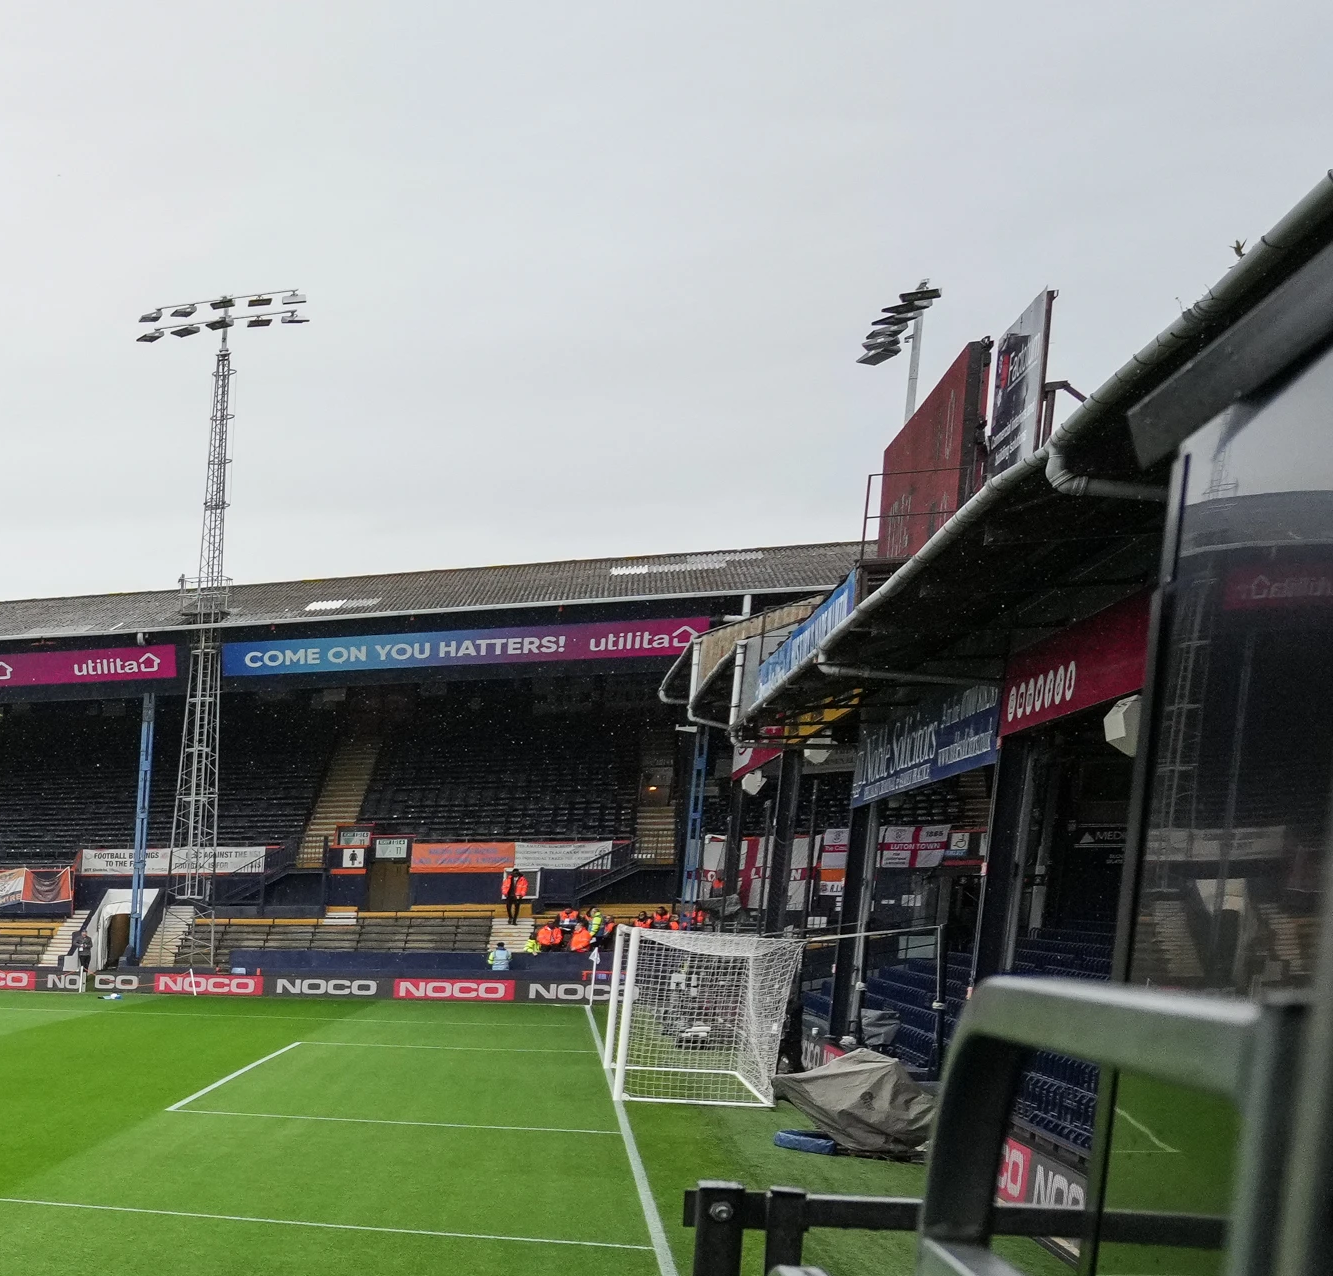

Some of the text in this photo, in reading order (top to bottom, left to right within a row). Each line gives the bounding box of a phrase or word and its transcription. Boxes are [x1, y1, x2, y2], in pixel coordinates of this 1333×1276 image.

[245, 630, 670, 668] COME ON YOU HATTERS! utilita
[73, 658, 138, 676] utilita
[893, 712, 938, 771] Solicitors
[93, 852, 127, 860] FOOTBALL
[105, 860, 128, 868] TO THE
[159, 975, 256, 993] NOCO
[277, 978, 377, 995] NOCO
[399, 981, 507, 998] NOCO
